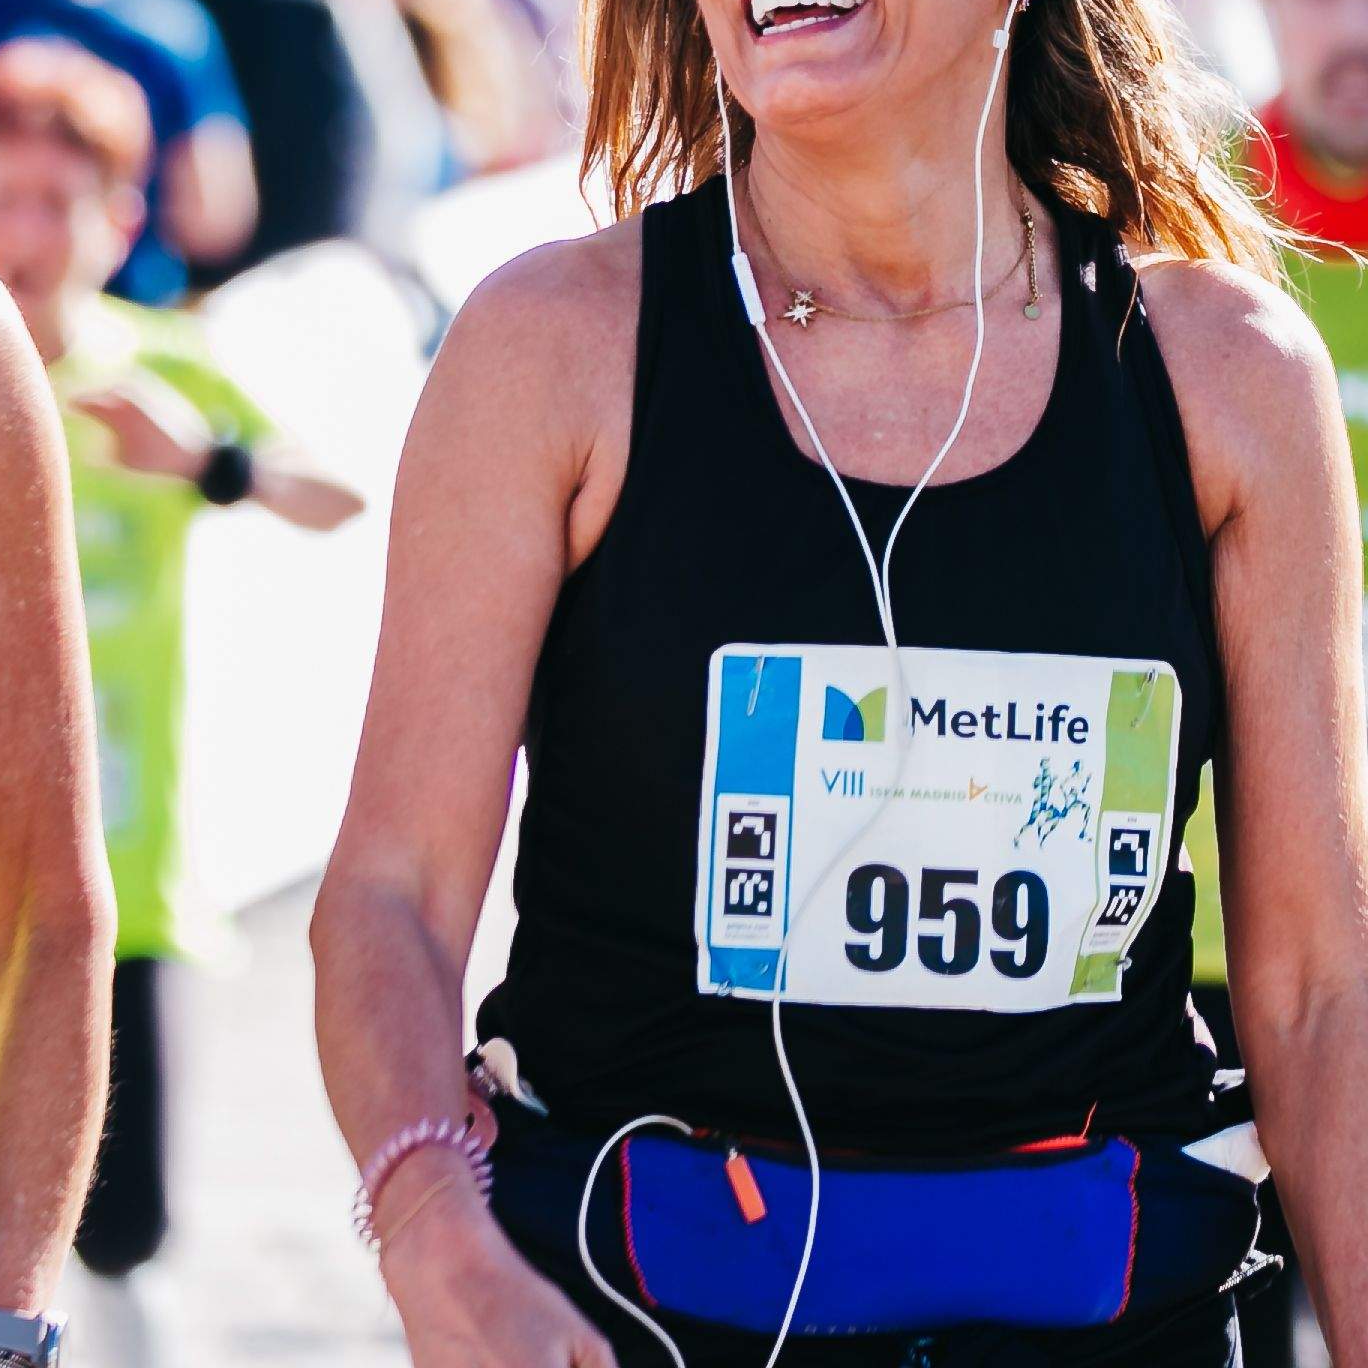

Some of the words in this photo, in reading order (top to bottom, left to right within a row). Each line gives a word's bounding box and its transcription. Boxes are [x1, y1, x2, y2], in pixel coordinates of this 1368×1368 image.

[910, 696, 1089, 745] MetLife
[820, 767, 866, 799] VIII
[843, 863, 1050, 980] 959
